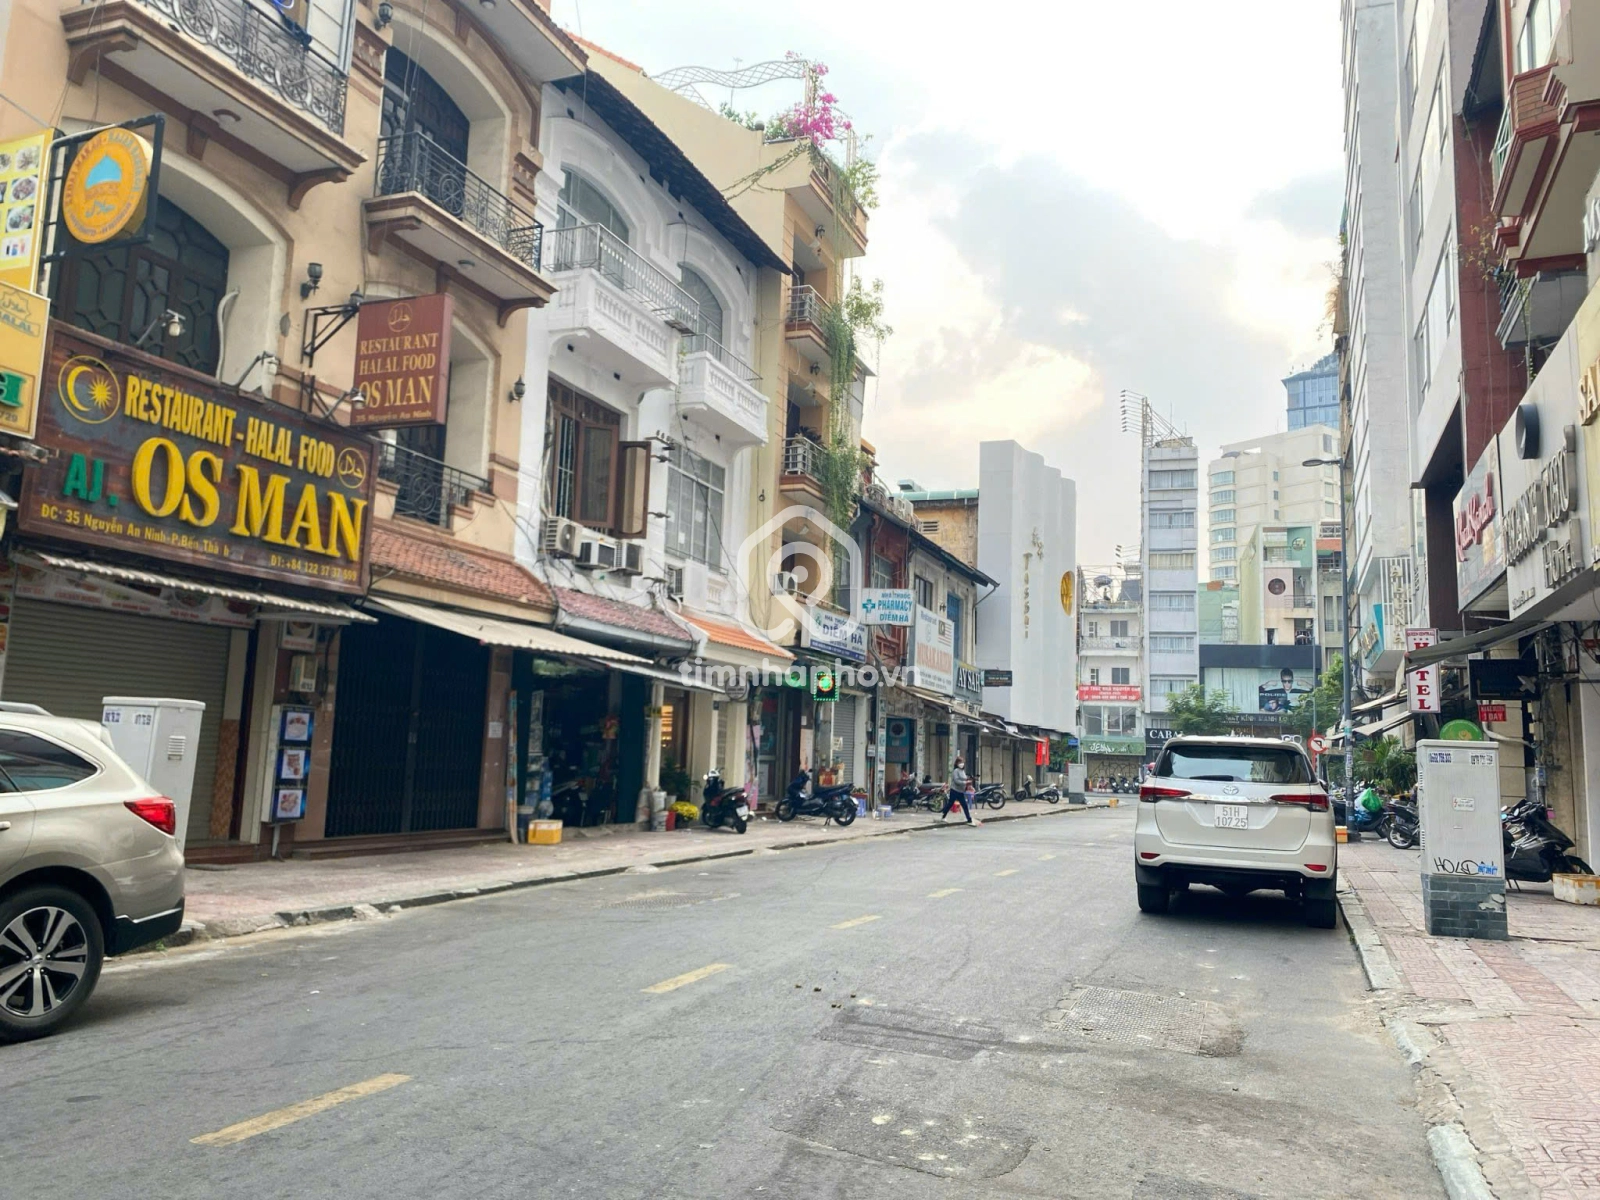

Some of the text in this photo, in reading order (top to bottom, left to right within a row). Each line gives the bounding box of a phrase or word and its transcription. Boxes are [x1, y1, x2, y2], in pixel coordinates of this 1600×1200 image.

[360, 333, 438, 355] RESTAURANT
[359, 353, 436, 375] HALAL FOOD
[360, 375, 434, 408] OS MAN
[124, 375, 236, 447] RESTAURANT
[245, 417, 292, 466] HALAL
[298, 435, 336, 478] FOOD
[132, 437, 223, 527] OS
[230, 464, 367, 562] MAN
[65, 508, 80, 524] 35
[84, 513, 123, 533] Nguyễn
[127, 523, 140, 538] An
[304, 561, 318, 574] 122
[878, 599, 912, 611] PHARMACY
[1414, 642, 1431, 710] HTEL
[1488, 712, 1503, 720] DAY
[1223, 807, 1239, 817] 51H
